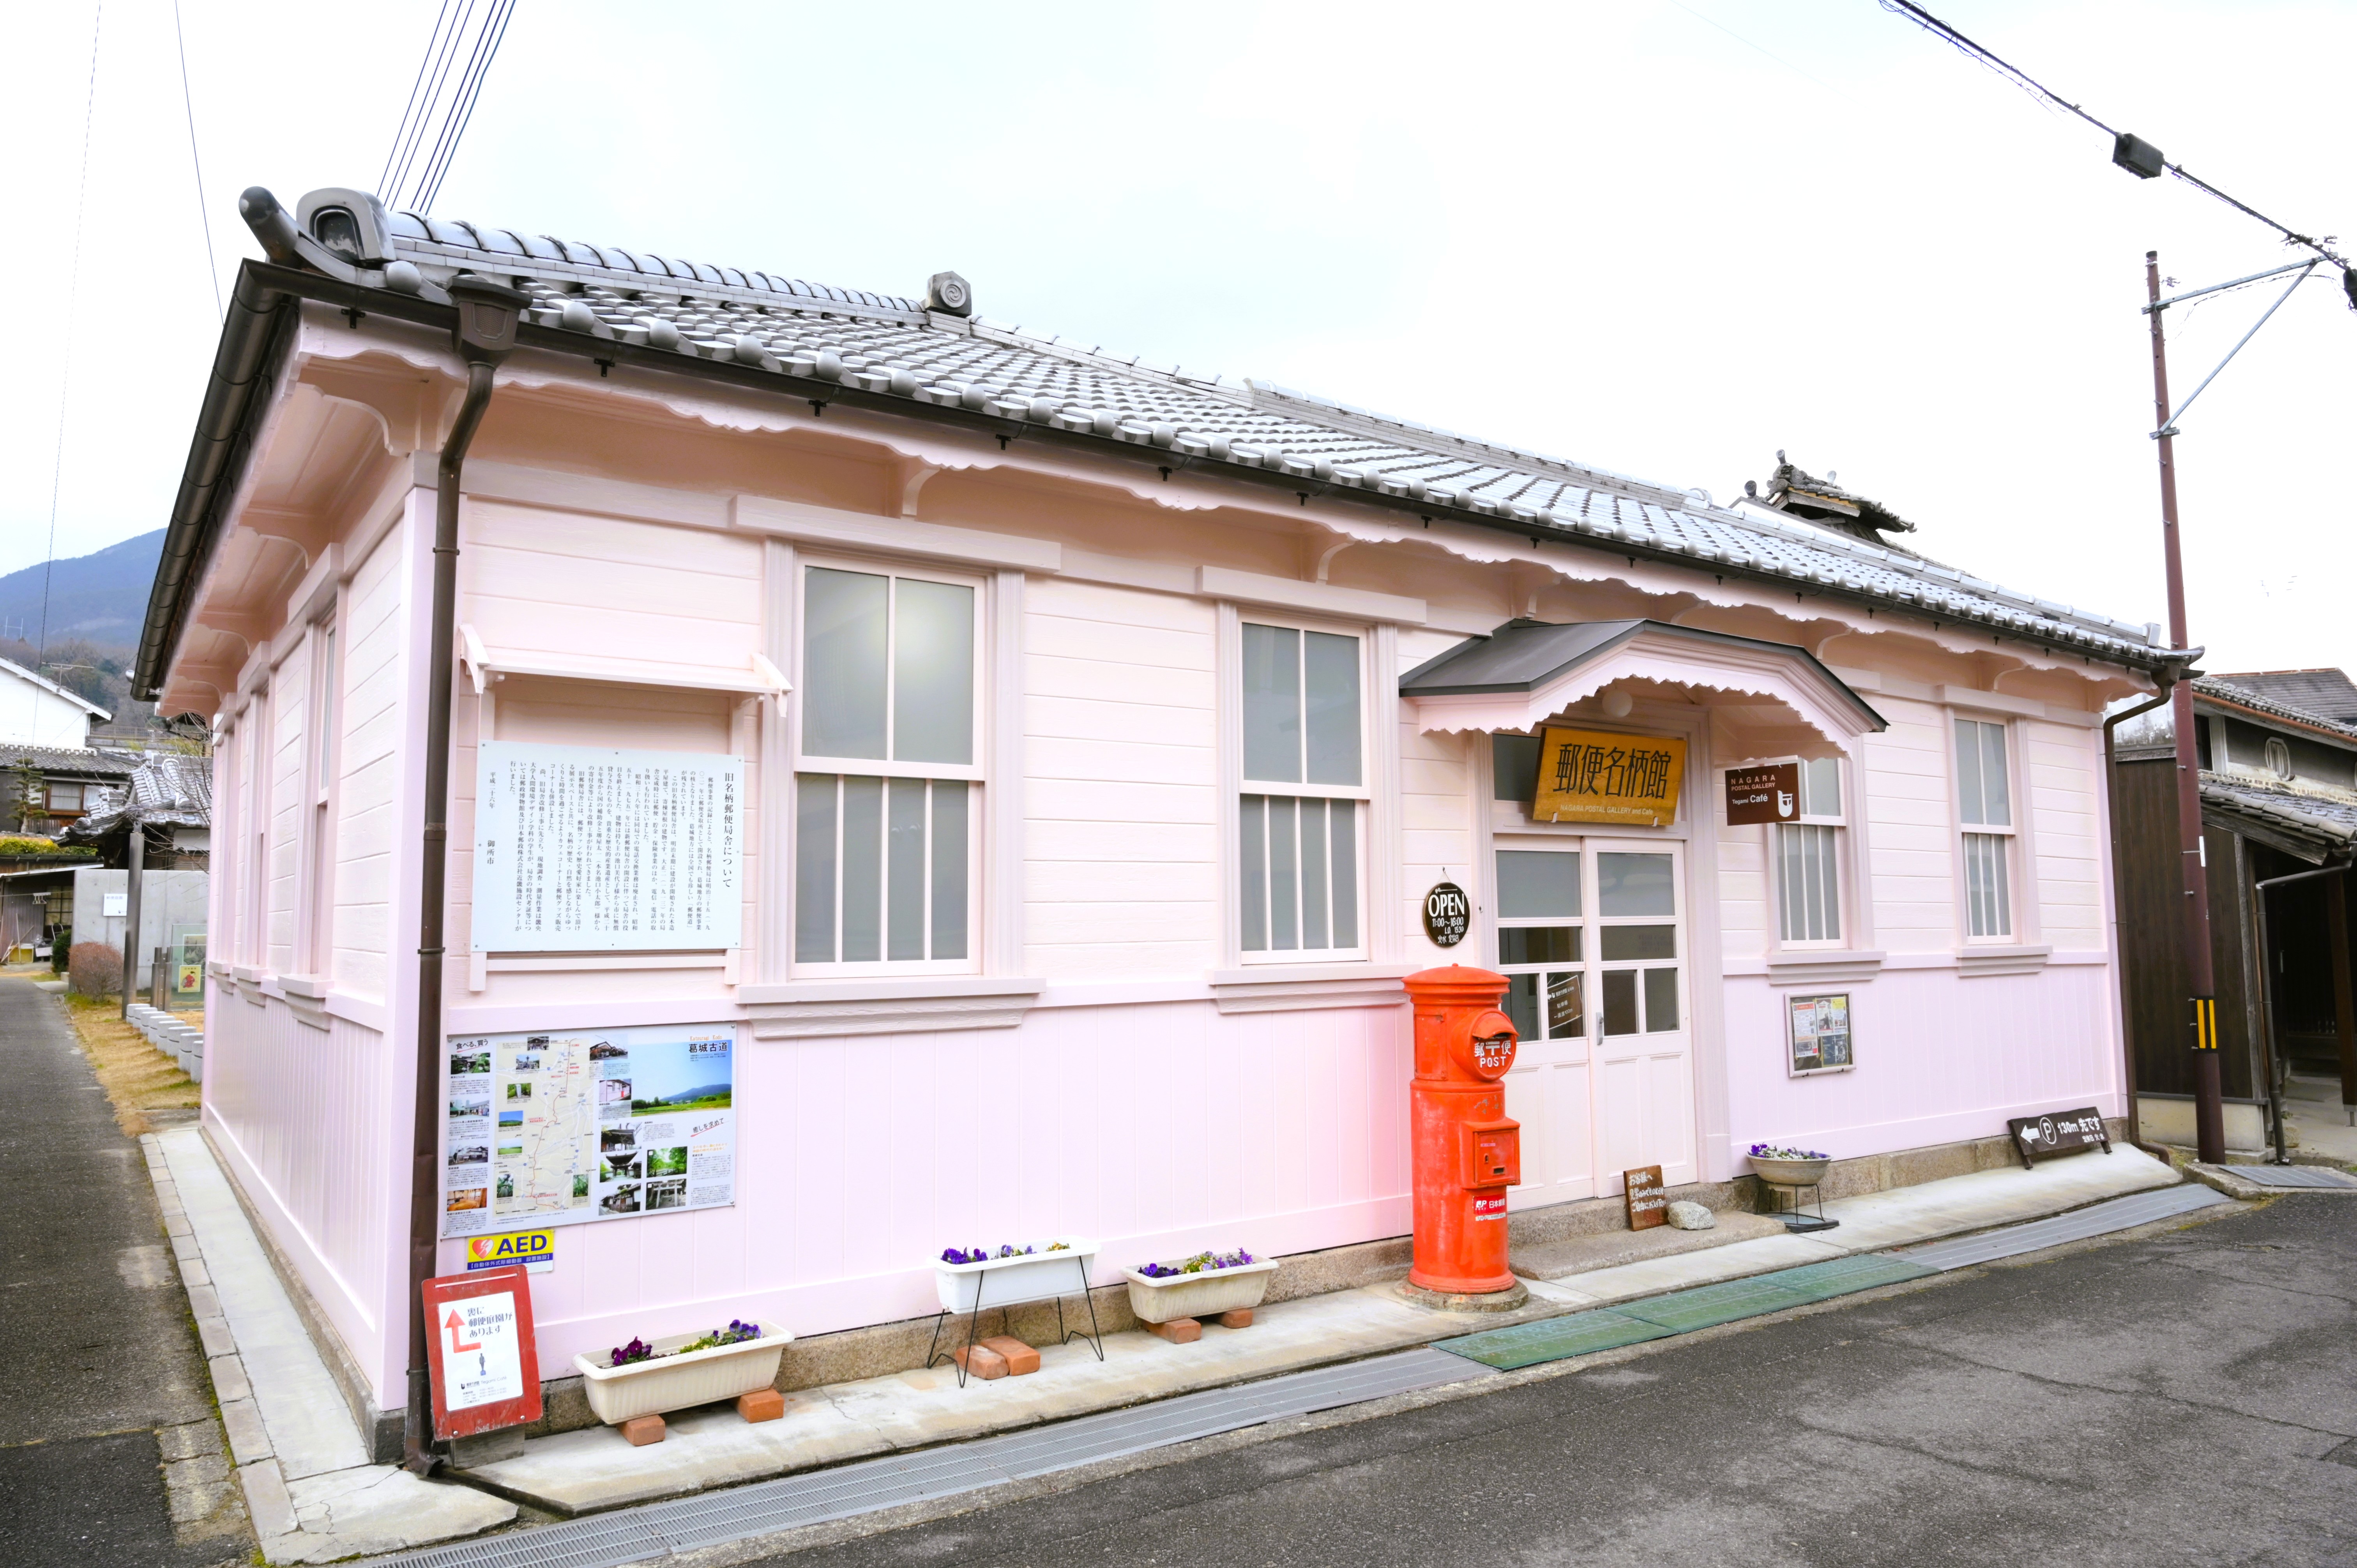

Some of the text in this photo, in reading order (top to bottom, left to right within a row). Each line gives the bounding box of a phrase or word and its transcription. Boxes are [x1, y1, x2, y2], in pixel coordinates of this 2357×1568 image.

[1553, 743, 1671, 799] 郵便名柄館
[1731, 774, 1776, 784] NAGARA
[1750, 793, 1768, 803] Café
[723, 772, 734, 888] 旧名柄郵便局舎について
[486, 840, 496, 865] 御所市
[1428, 893, 1465, 917] OPEN
[456, 1039, 488, 1050] 食べる、買う
[689, 1042, 728, 1053] 葛城古道
[1480, 1056, 1506, 1068] POST
[693, 1118, 724, 1134] 癒しを求めて
[2042, 1116, 2101, 1141] P 130m 先です
[2082, 1134, 2094, 1143] 定休日
[1629, 1171, 1653, 1186] お客様へ
[1629, 1186, 1664, 1200] 見学のみでもOKです
[1489, 1198, 1505, 1208] 日本郵便
[1631, 1198, 1666, 1212] ご自由にお入り下さい
[496, 1234, 547, 1255] AED
[471, 1254, 550, 1269] 【自動体外式除細動器 設置施設】
[467, 1307, 485, 1316] 裏に
[468, 1312, 512, 1328] 郵便庭園が
[469, 1325, 502, 1338] あります
